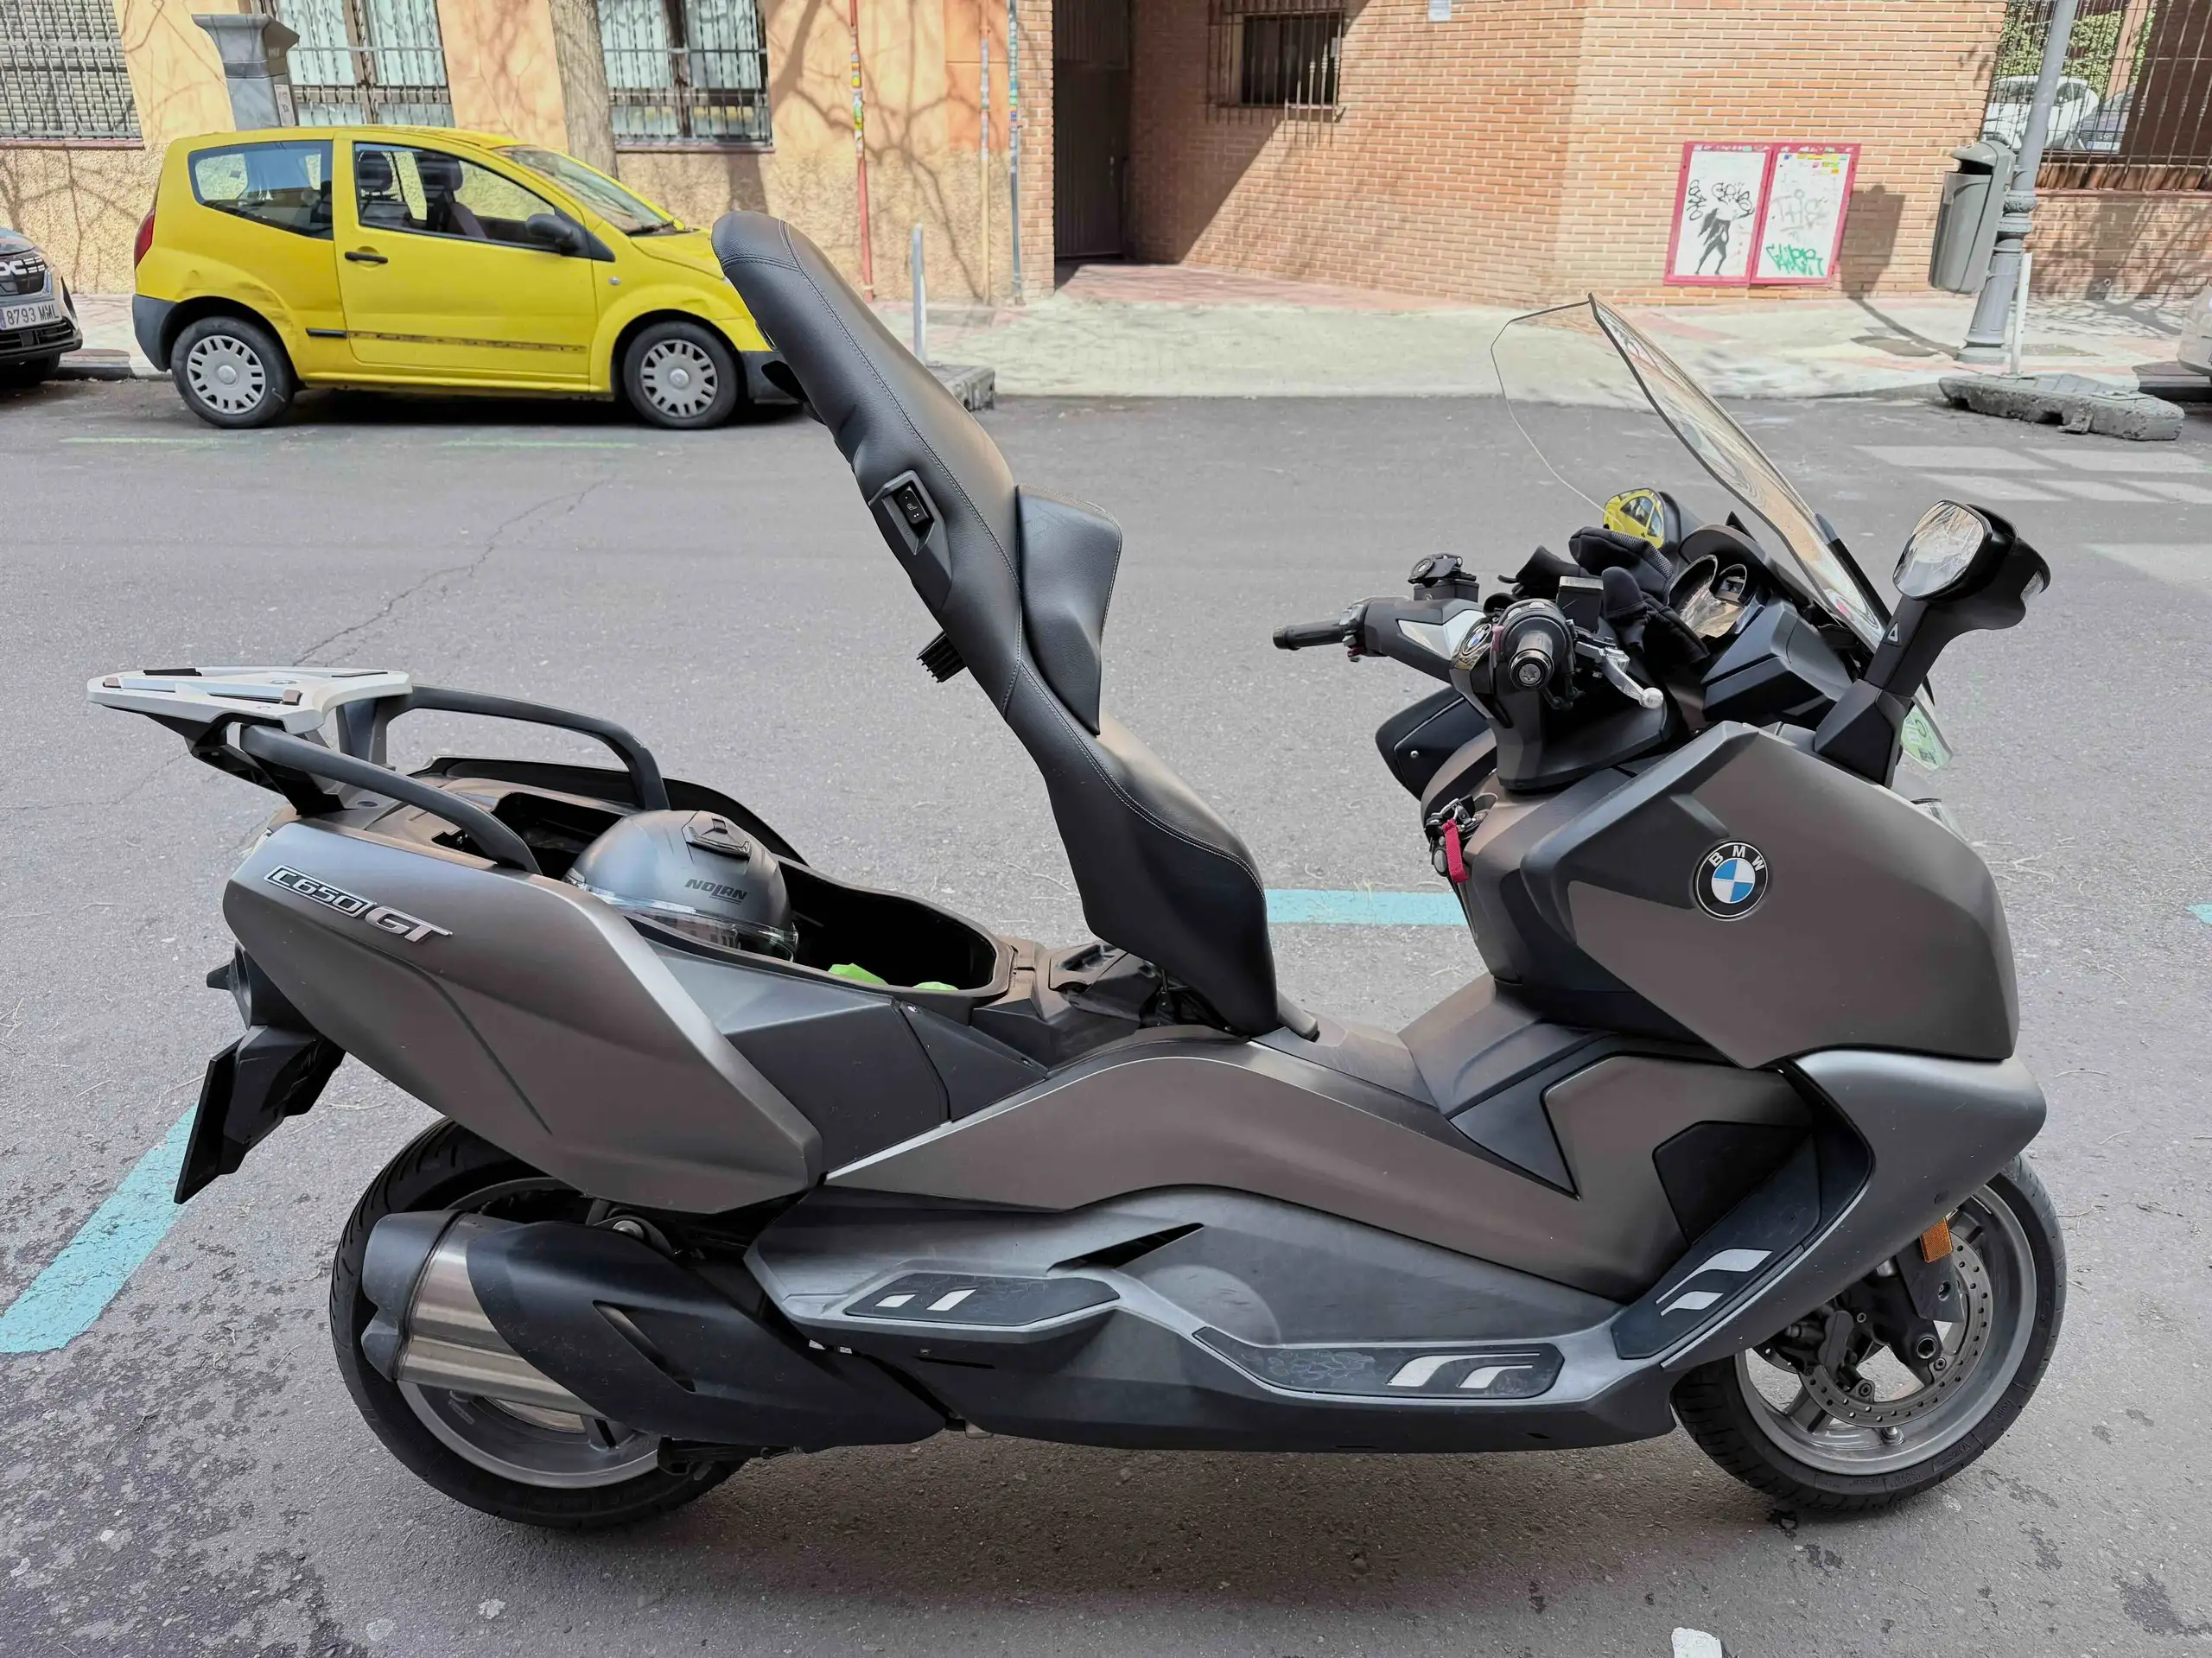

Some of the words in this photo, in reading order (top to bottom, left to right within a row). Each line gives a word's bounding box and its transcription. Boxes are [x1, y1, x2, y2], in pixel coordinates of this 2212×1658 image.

[6, 307, 36, 326] 8793
[37, 303, 60, 321] MML
[1708, 845, 1765, 872] BMW
[684, 879, 748, 903] NOLAN
[365, 905, 454, 943] GT
